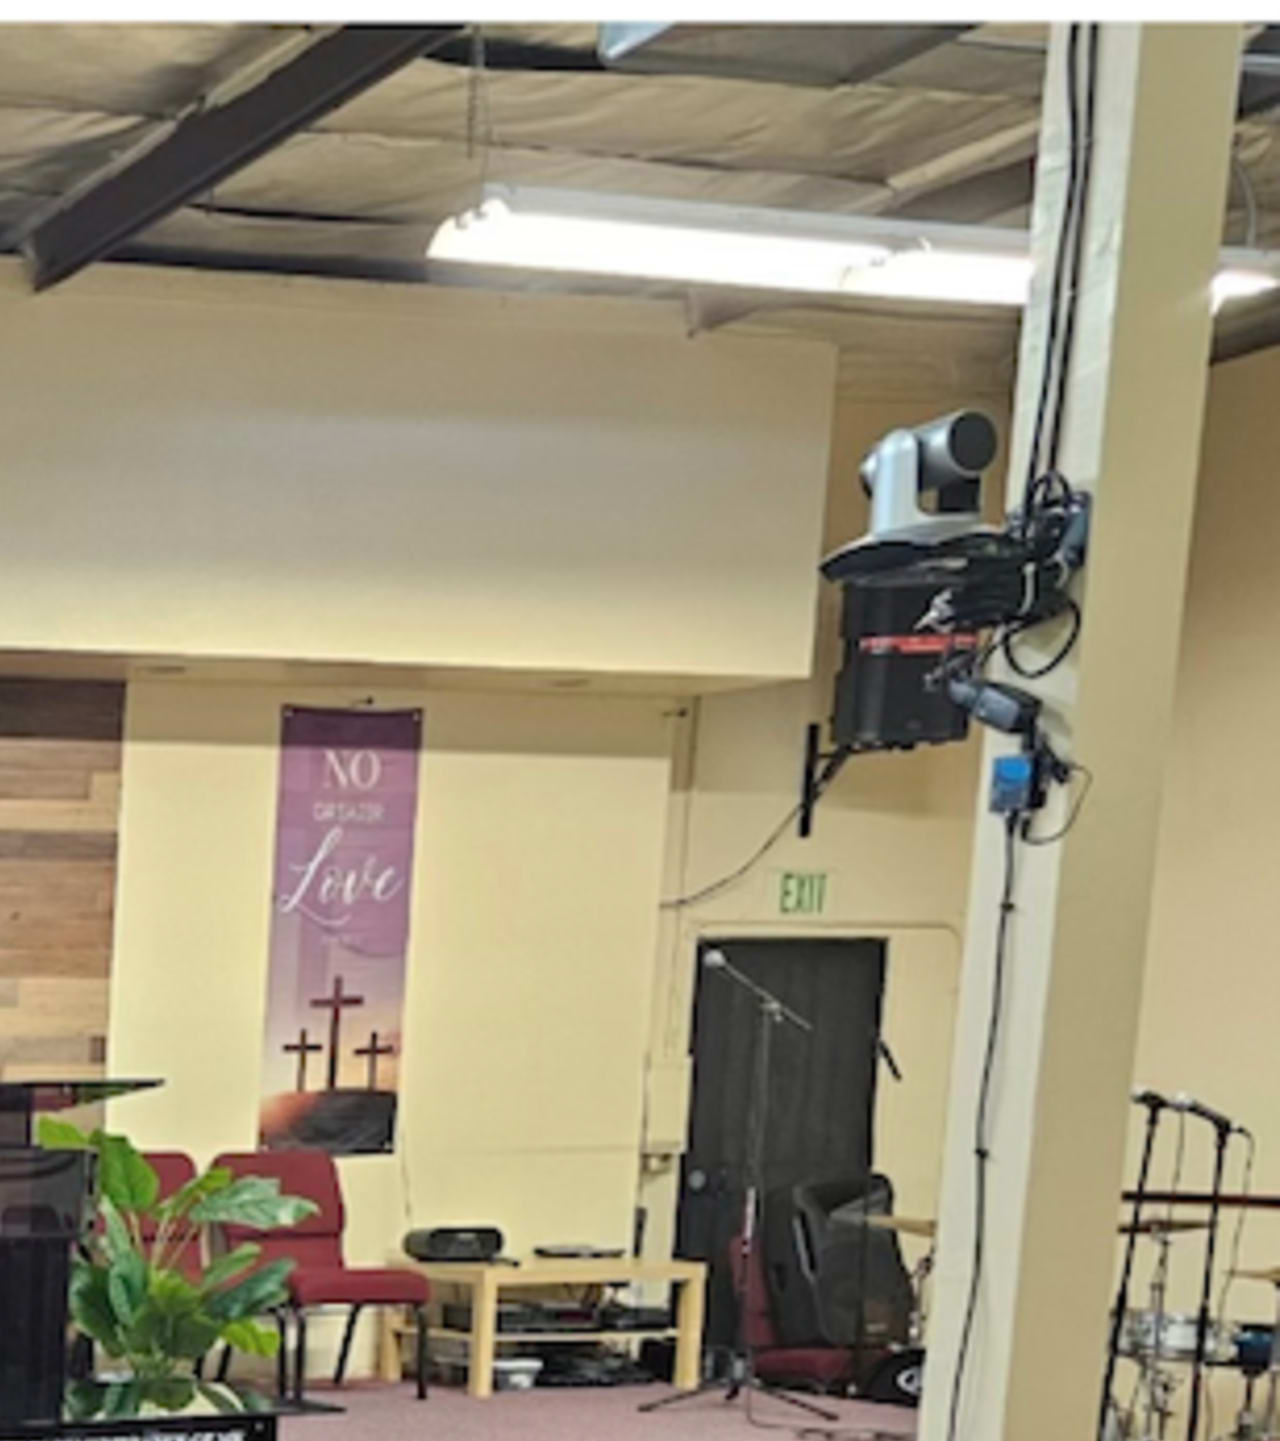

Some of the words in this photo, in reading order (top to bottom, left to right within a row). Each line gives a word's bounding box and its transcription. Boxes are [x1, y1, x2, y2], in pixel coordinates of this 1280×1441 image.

[322, 749, 382, 790] NO
[278, 826, 404, 927] Love
[780, 873, 827, 913] EXIT
